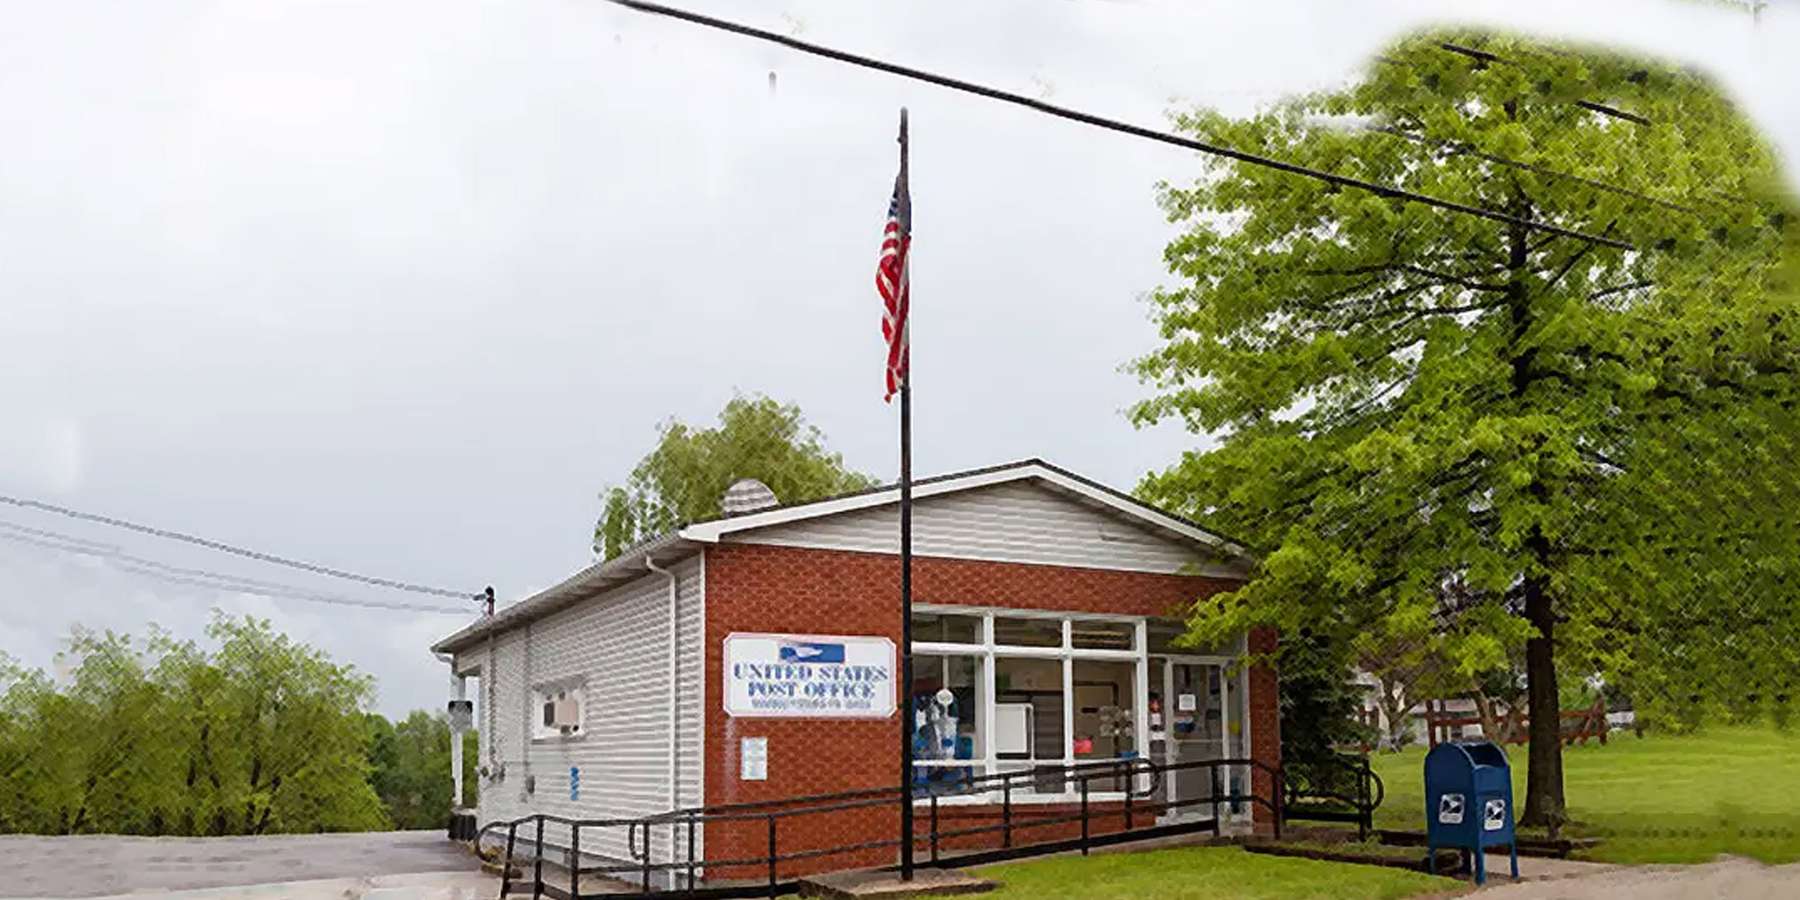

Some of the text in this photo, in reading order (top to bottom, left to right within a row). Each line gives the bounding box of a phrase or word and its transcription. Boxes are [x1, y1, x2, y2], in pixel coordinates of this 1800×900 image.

[734, 663, 888, 682] UNITED STATES
[748, 681, 875, 699] POST OFFICE
